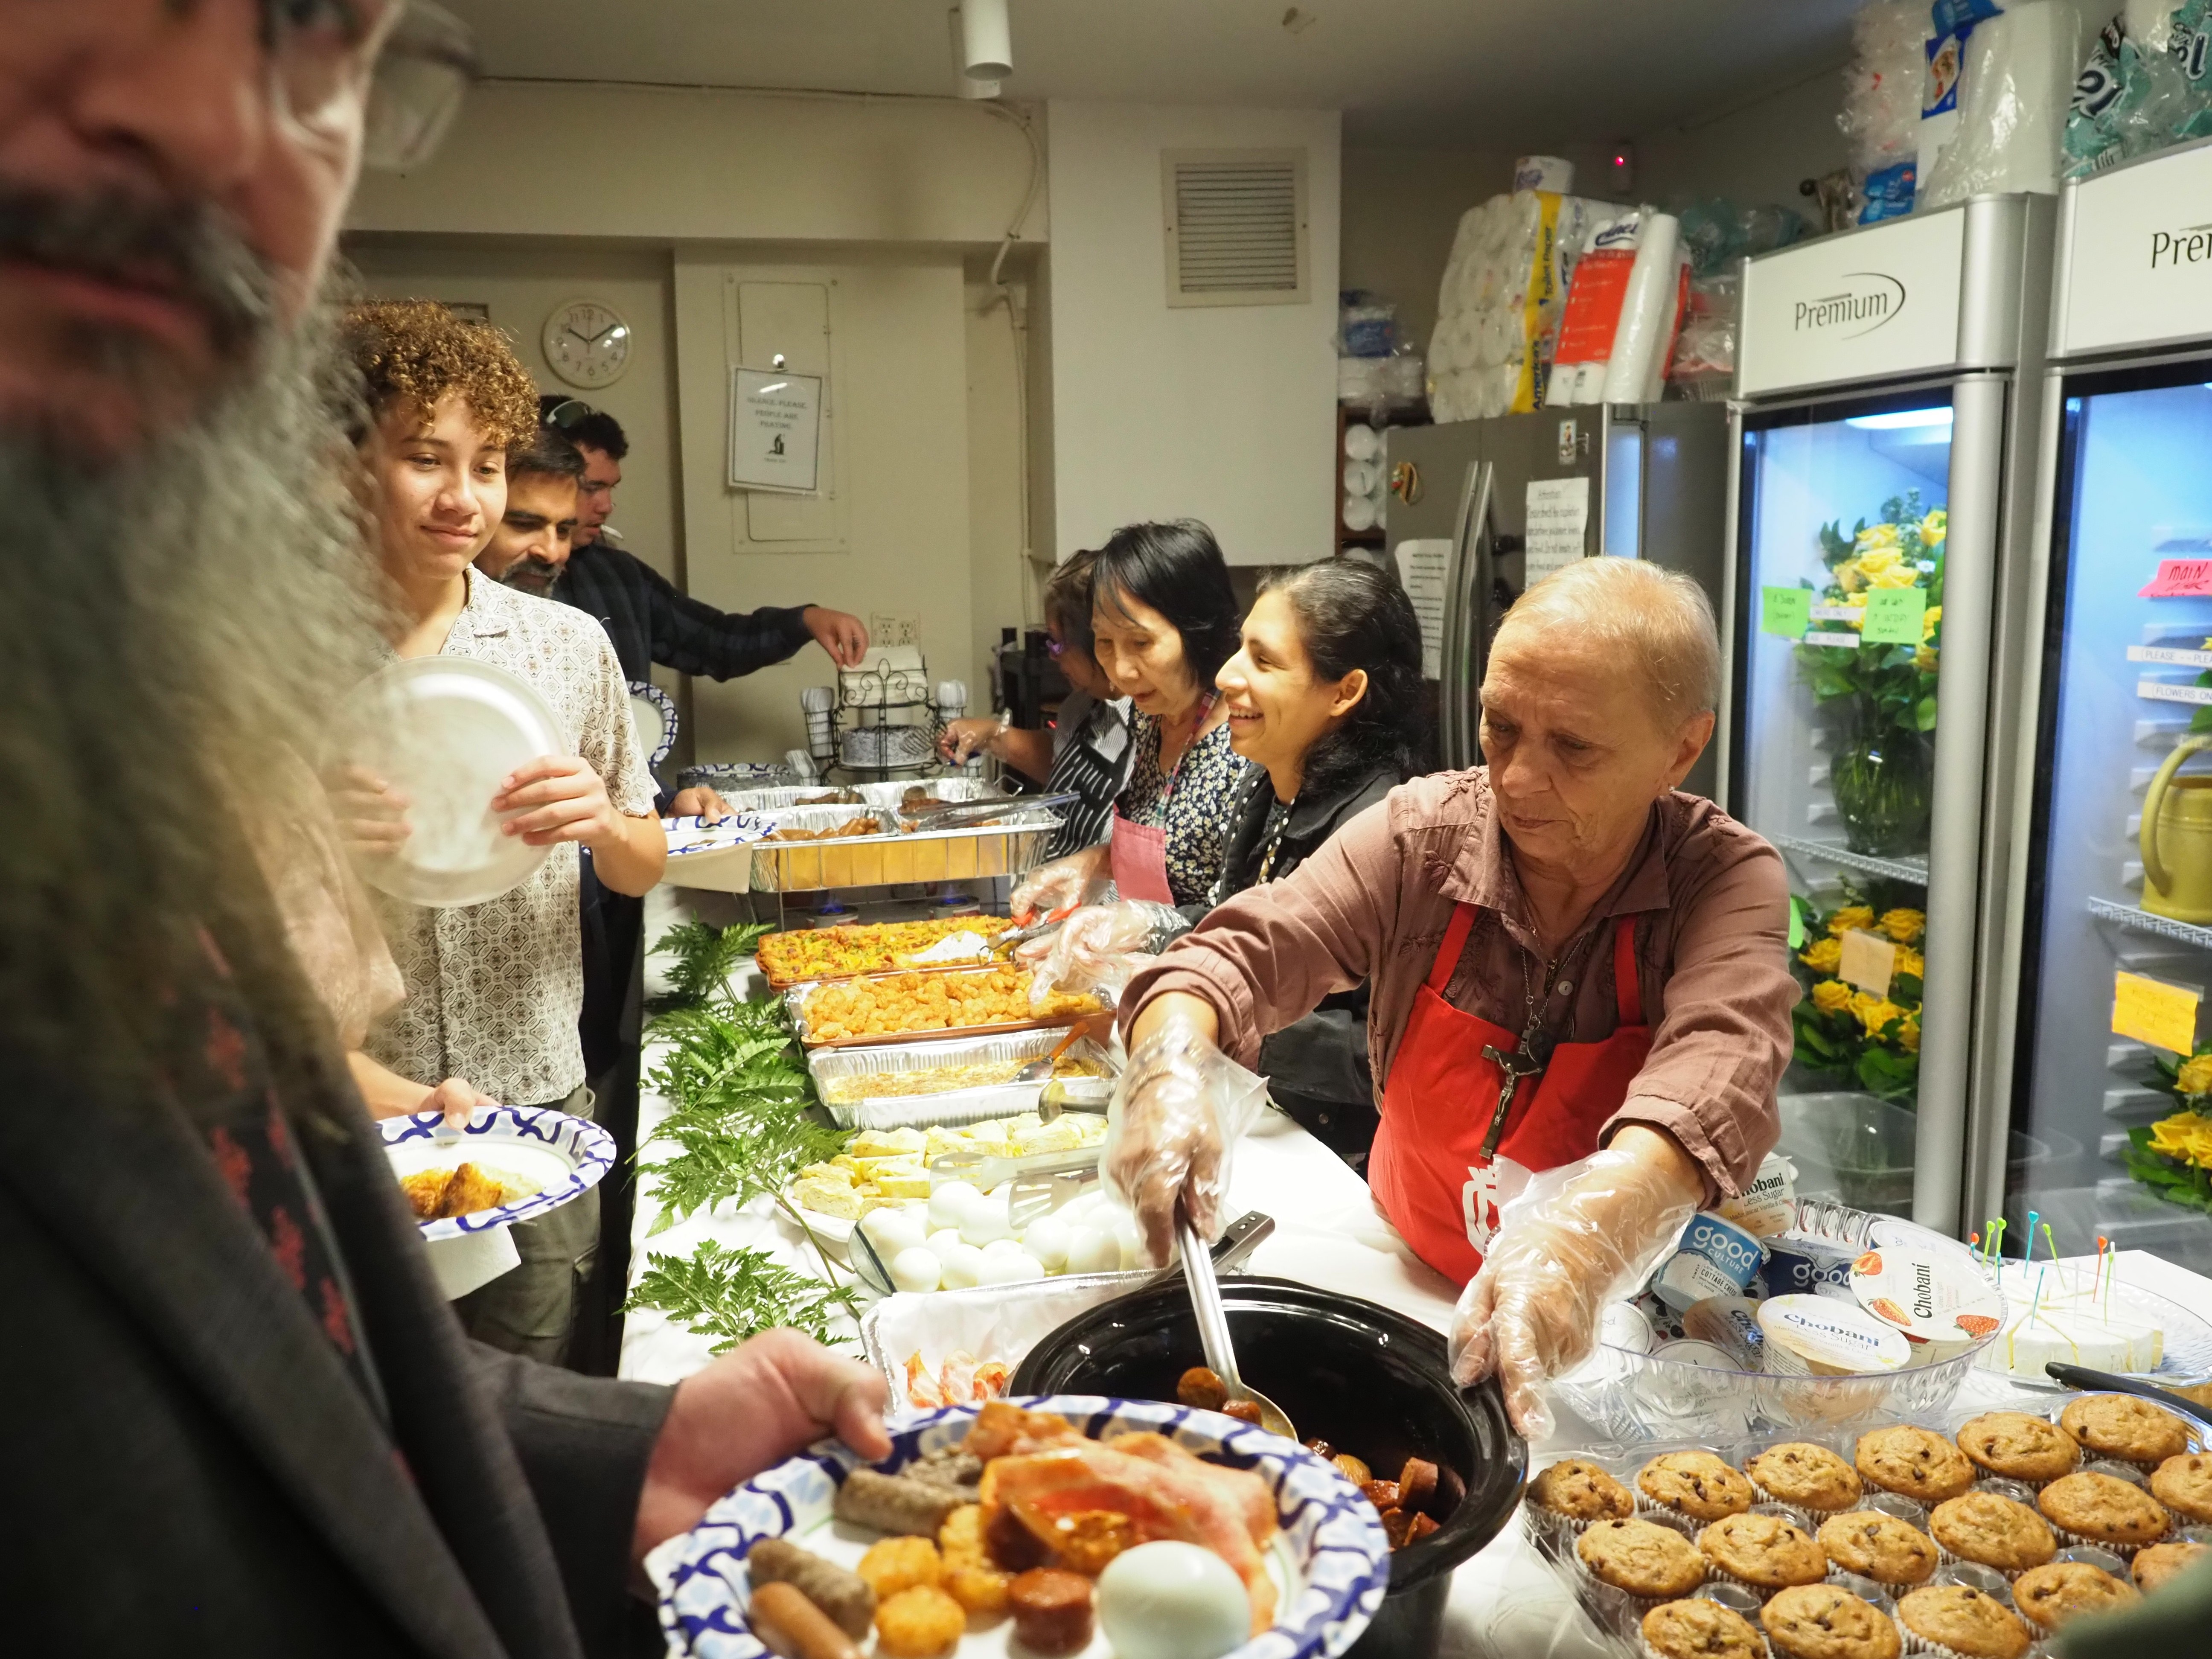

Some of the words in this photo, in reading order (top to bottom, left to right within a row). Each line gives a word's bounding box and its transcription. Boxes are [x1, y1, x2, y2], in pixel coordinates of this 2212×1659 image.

[1795, 293, 1887, 331] Premium
[2145, 650, 2176, 661] PLEASE
[2156, 686, 2196, 699] FLOWERS
[1762, 1188, 1784, 1200] Sugar
[1693, 1226, 1759, 1270] good
[1708, 1248, 1745, 1274] CULTURE
[1692, 1264, 1700, 1279] SIMPLY
[1701, 1269, 1724, 1286] COTTAGE
[1912, 1263, 1933, 1319] Chobani
[1784, 1313, 1880, 1347] Chobani
[1830, 1333, 1873, 1350] Sugar
